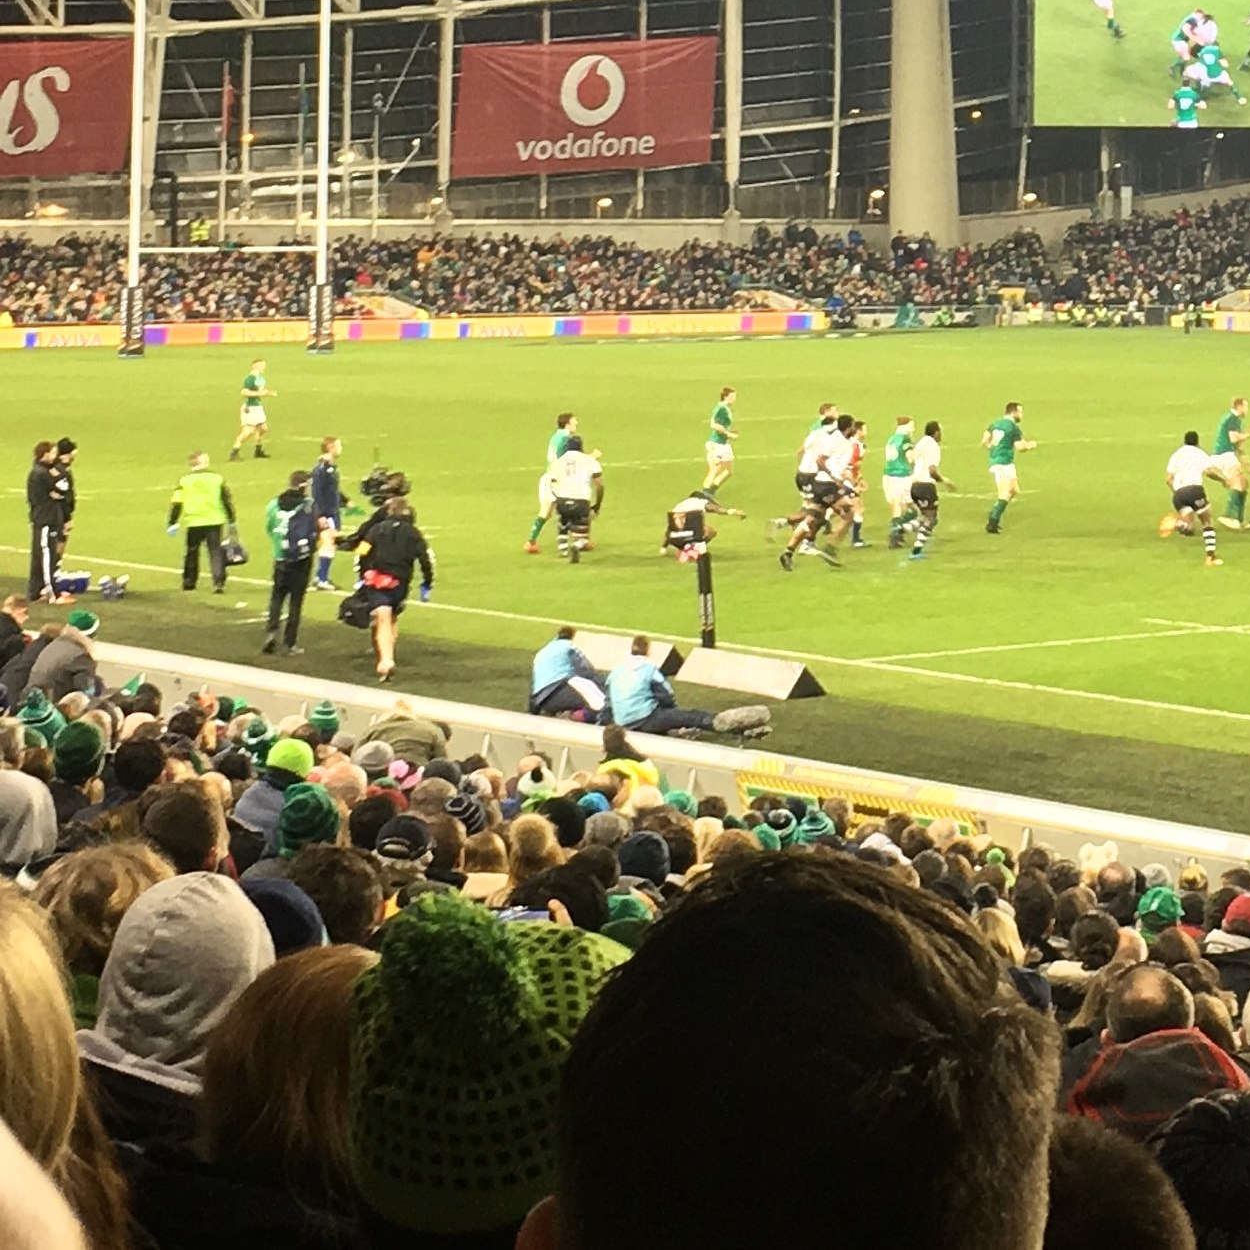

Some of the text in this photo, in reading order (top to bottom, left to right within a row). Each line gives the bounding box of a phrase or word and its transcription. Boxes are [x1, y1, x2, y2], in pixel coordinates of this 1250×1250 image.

[515, 131, 656, 162] vodafone
[479, 323, 527, 338] AVIVA
[47, 333, 103, 348] AVIVA
